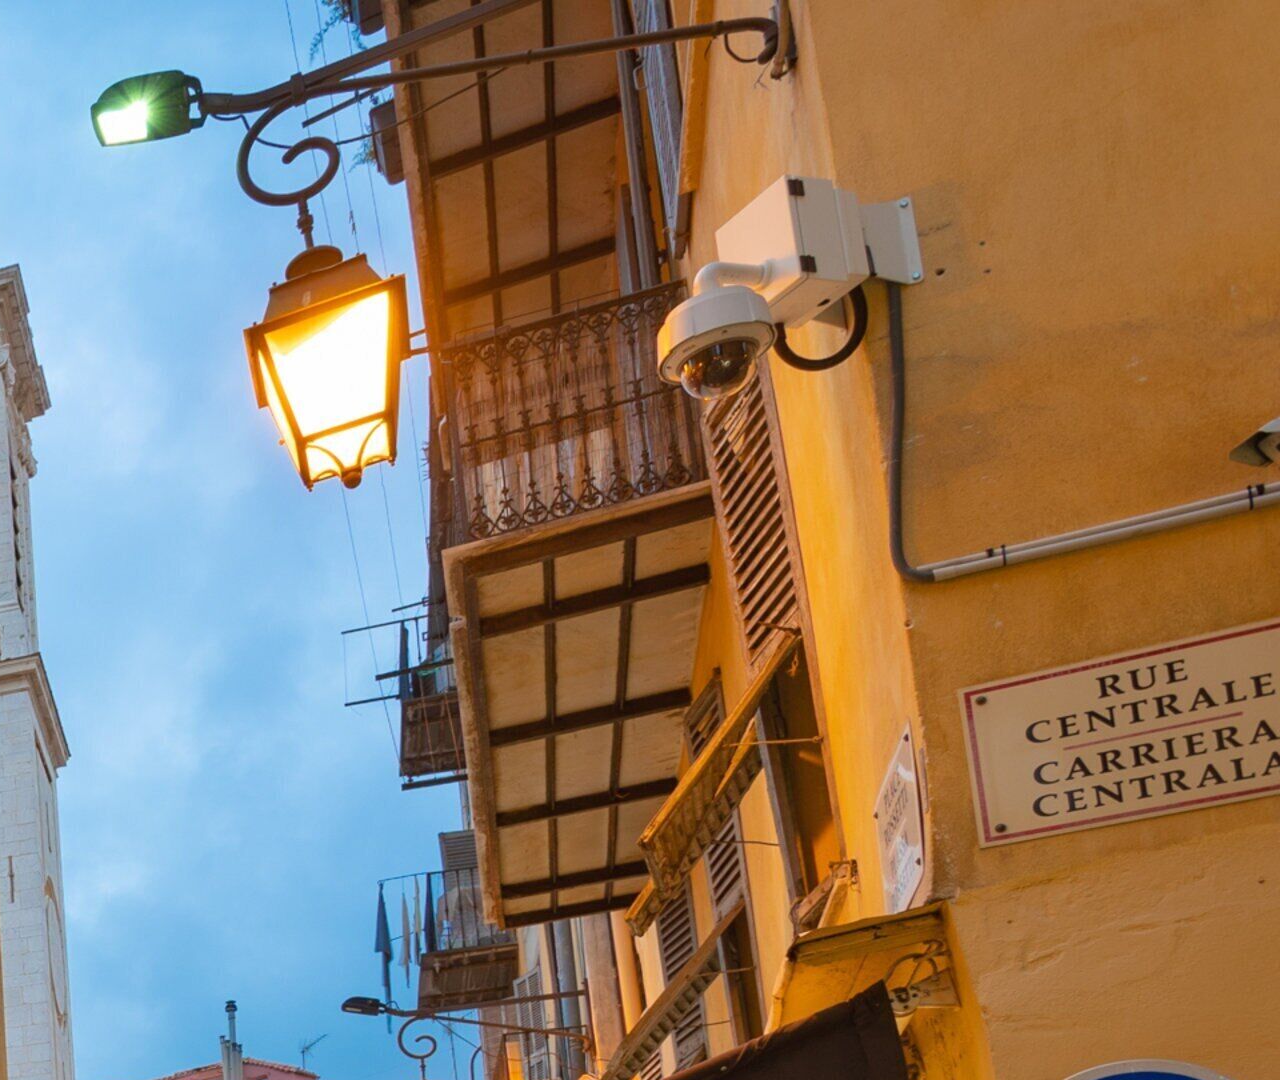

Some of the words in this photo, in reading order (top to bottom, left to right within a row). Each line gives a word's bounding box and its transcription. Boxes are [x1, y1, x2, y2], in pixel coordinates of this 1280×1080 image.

[1025, 673, 1276, 743] CENTRALE
[1096, 659, 1189, 699] RUE
[1032, 750, 1280, 817] CENTRALA
[1033, 719, 1280, 785] CARRIERA
